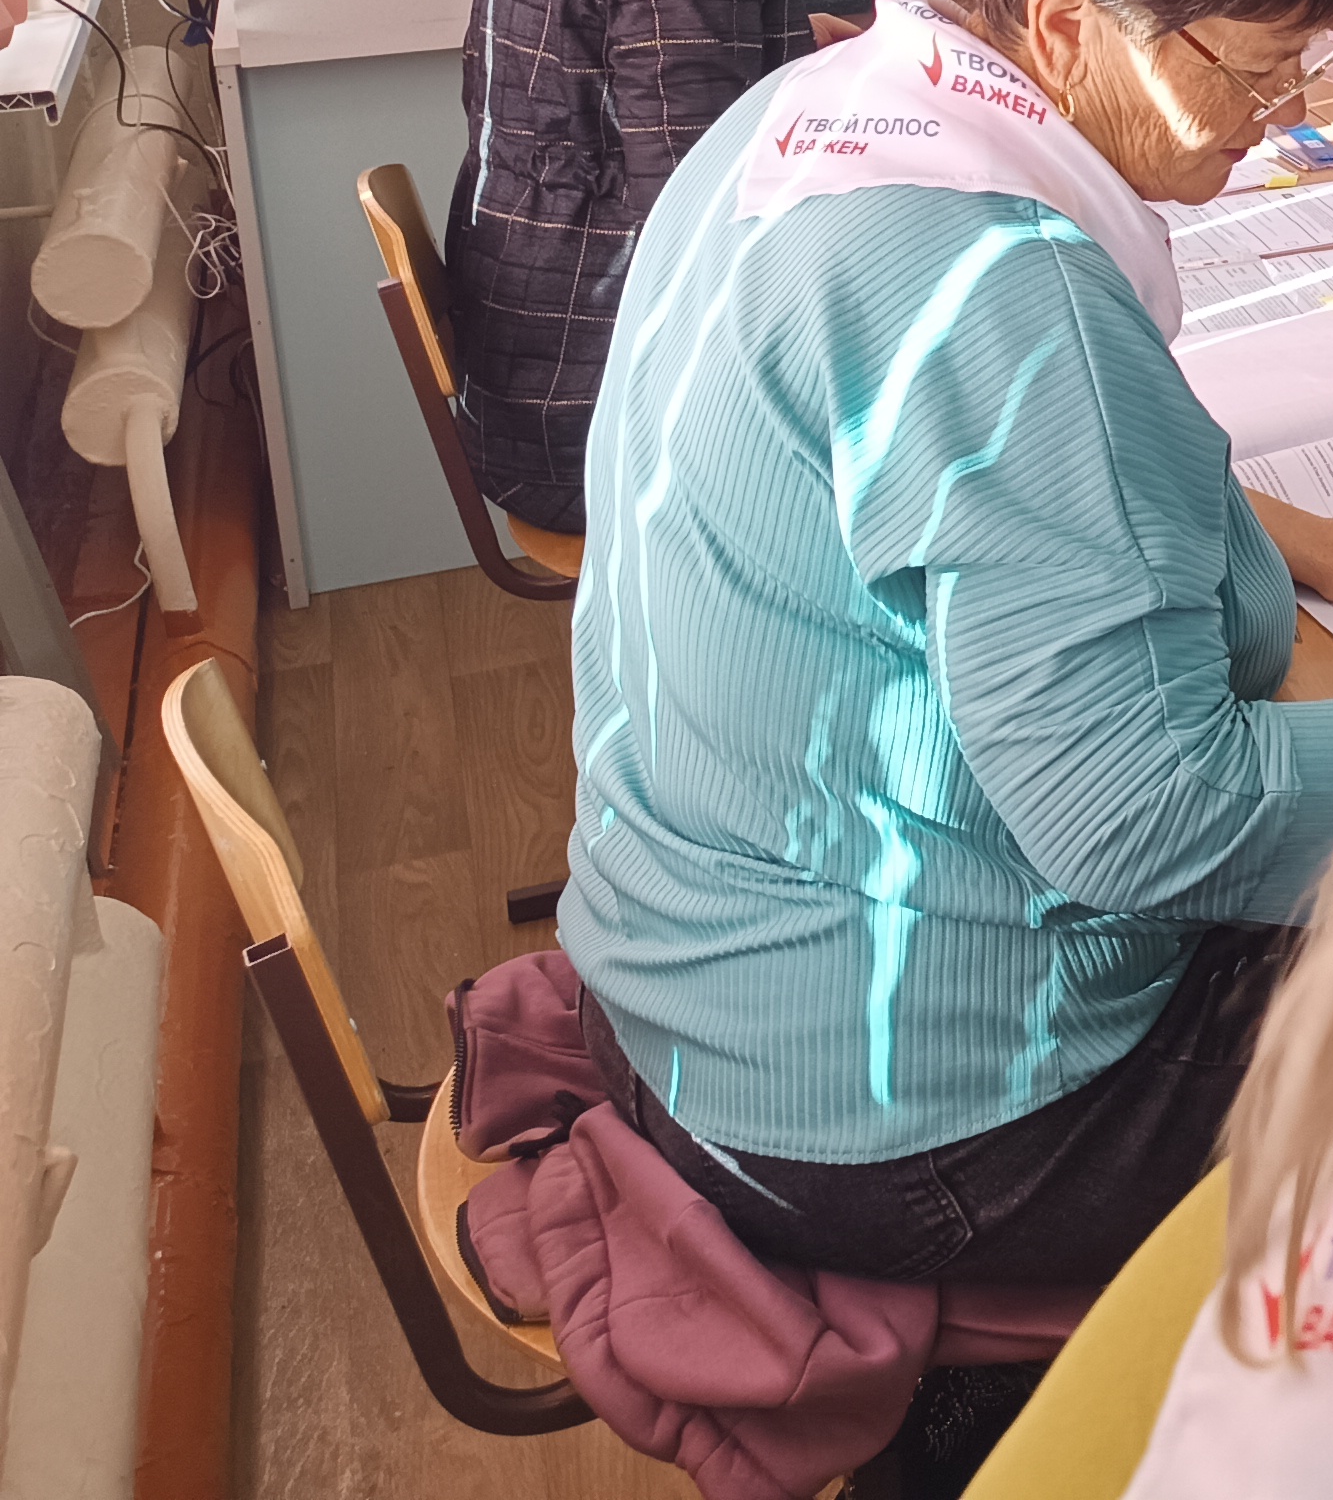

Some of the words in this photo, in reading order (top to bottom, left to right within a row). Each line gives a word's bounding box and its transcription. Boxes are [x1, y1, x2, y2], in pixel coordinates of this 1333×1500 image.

[951, 74, 1047, 125] ВАЖЕН
[804, 113, 858, 134] ТВОЙ
[863, 118, 941, 137] ГОЛОС
[793, 139, 868, 157] ВАЖЕН
